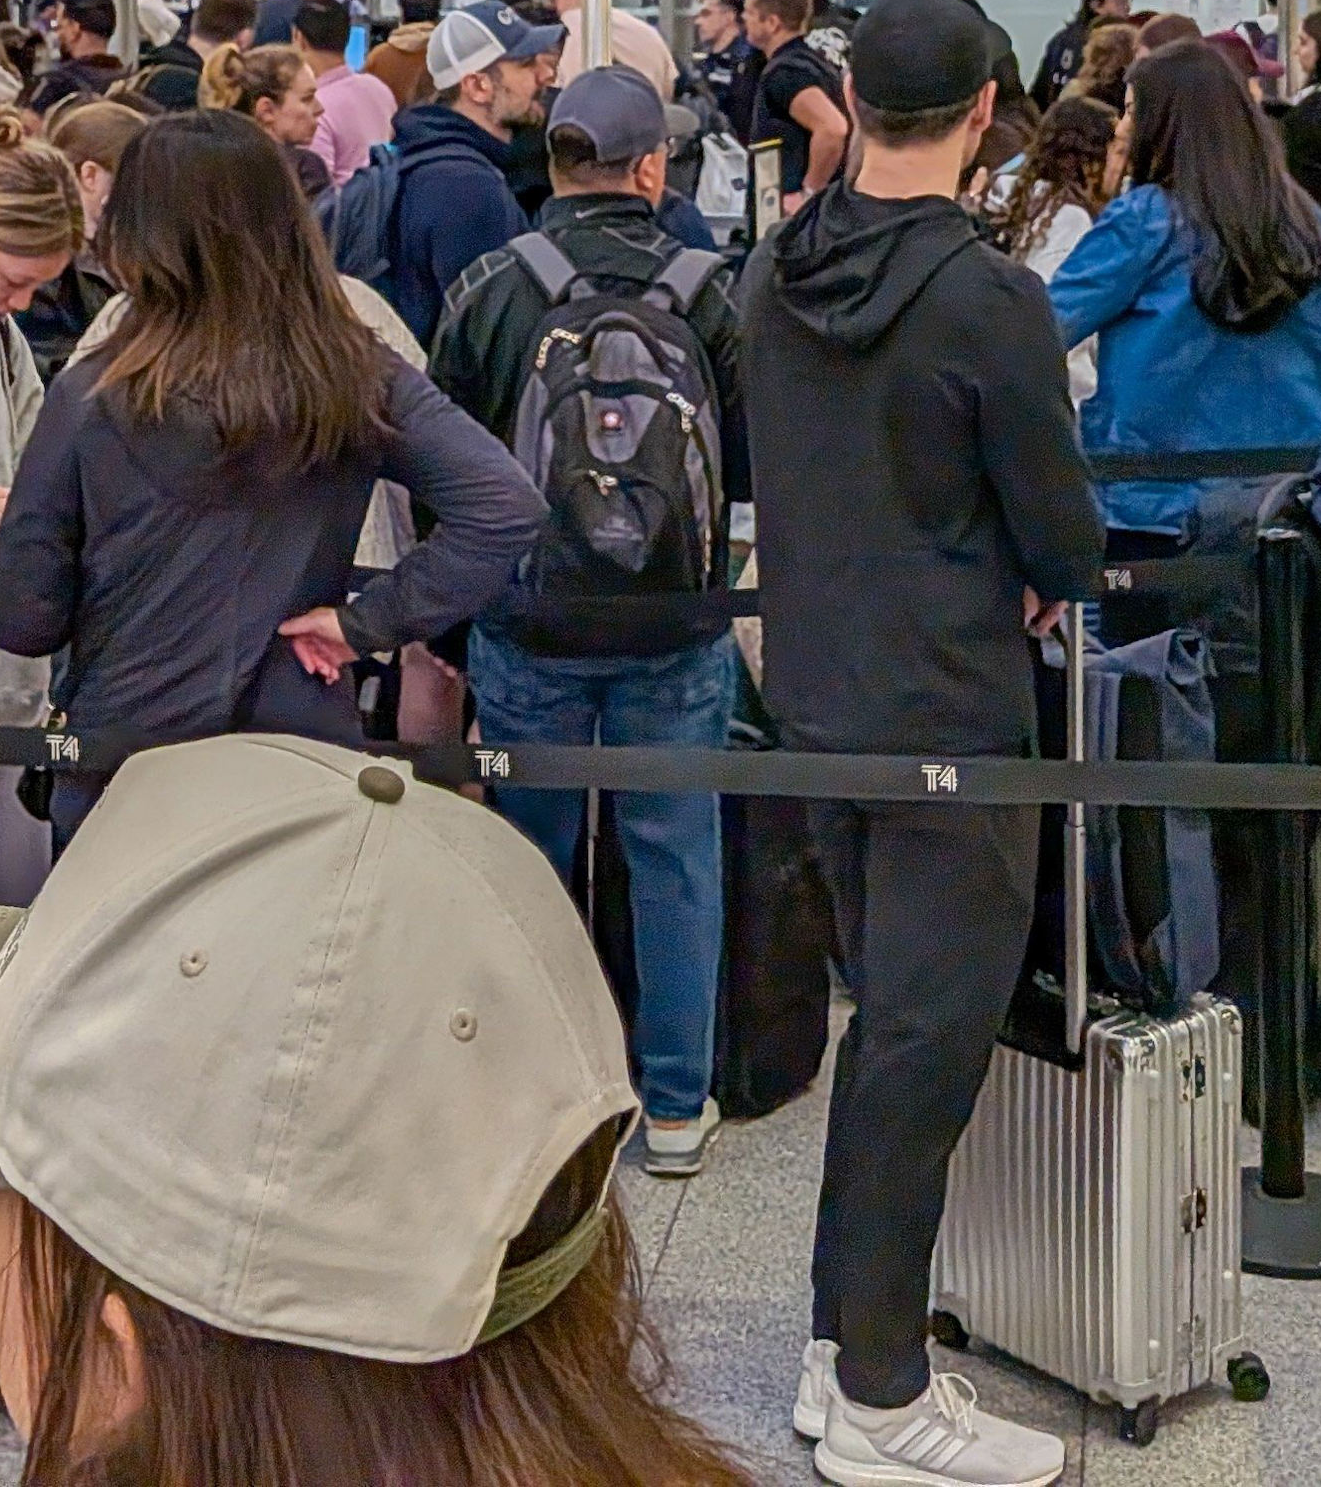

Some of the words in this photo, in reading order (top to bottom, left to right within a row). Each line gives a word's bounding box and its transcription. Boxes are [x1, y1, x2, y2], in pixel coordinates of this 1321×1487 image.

[1104, 569, 1132, 590] T4
[46, 734, 80, 762] T4
[474, 750, 510, 777] T4
[921, 764, 958, 792] T4
